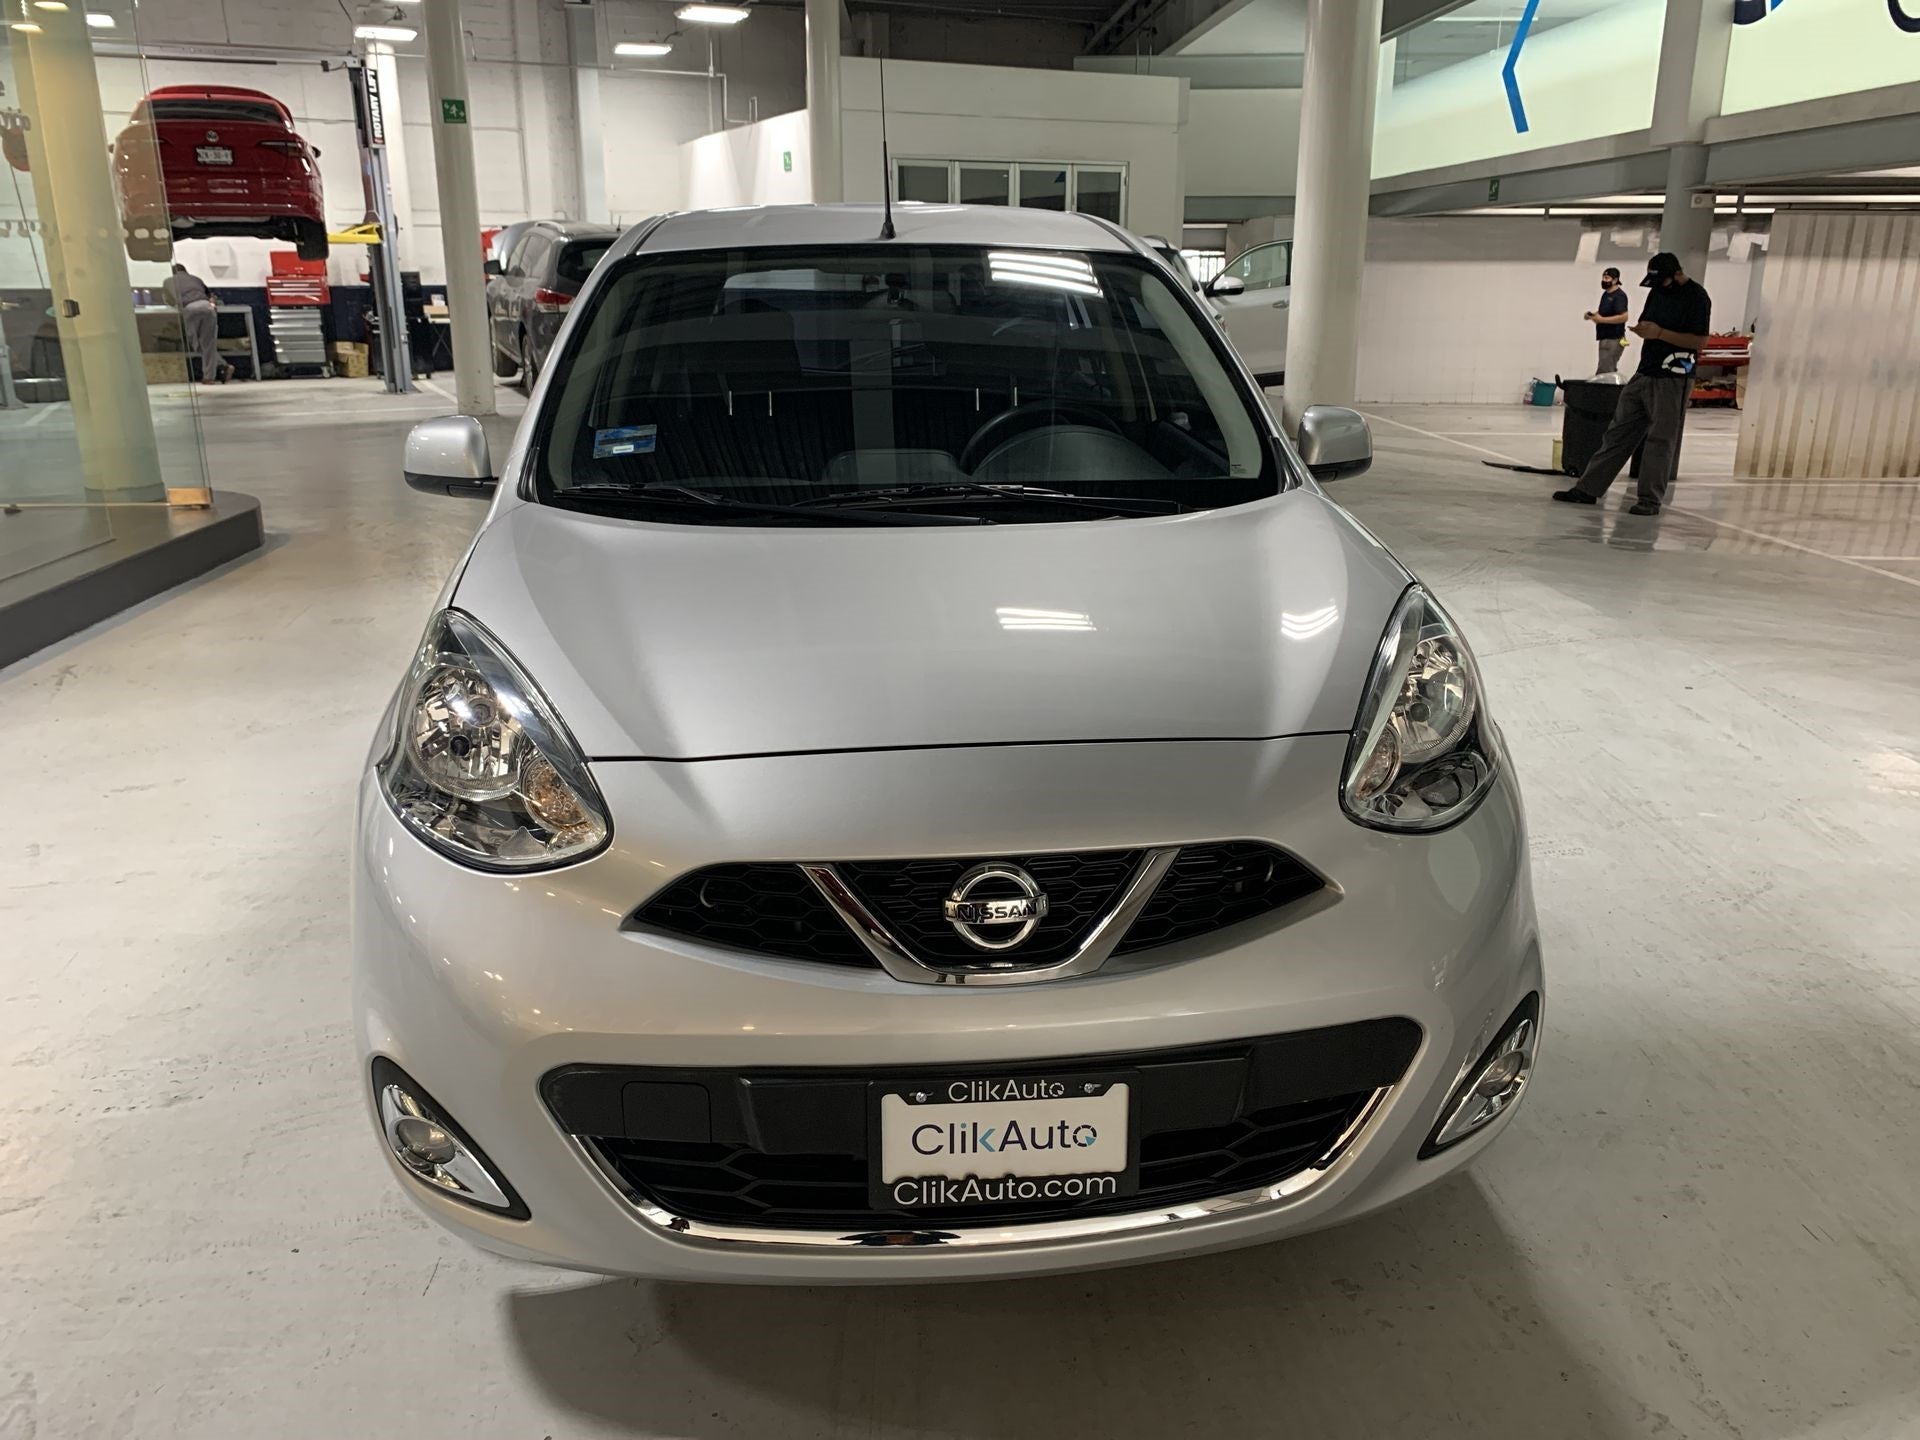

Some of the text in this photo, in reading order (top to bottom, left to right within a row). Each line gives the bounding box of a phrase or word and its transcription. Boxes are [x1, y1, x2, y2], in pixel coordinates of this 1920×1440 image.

[366, 68, 383, 138] ROTARY LIFT
[956, 902, 1038, 920] NISSAN
[948, 1079, 1065, 1102] ClikAuto
[912, 1120, 1097, 1155] ClikAuto
[893, 1175, 1116, 1206] ClikAuto.com
